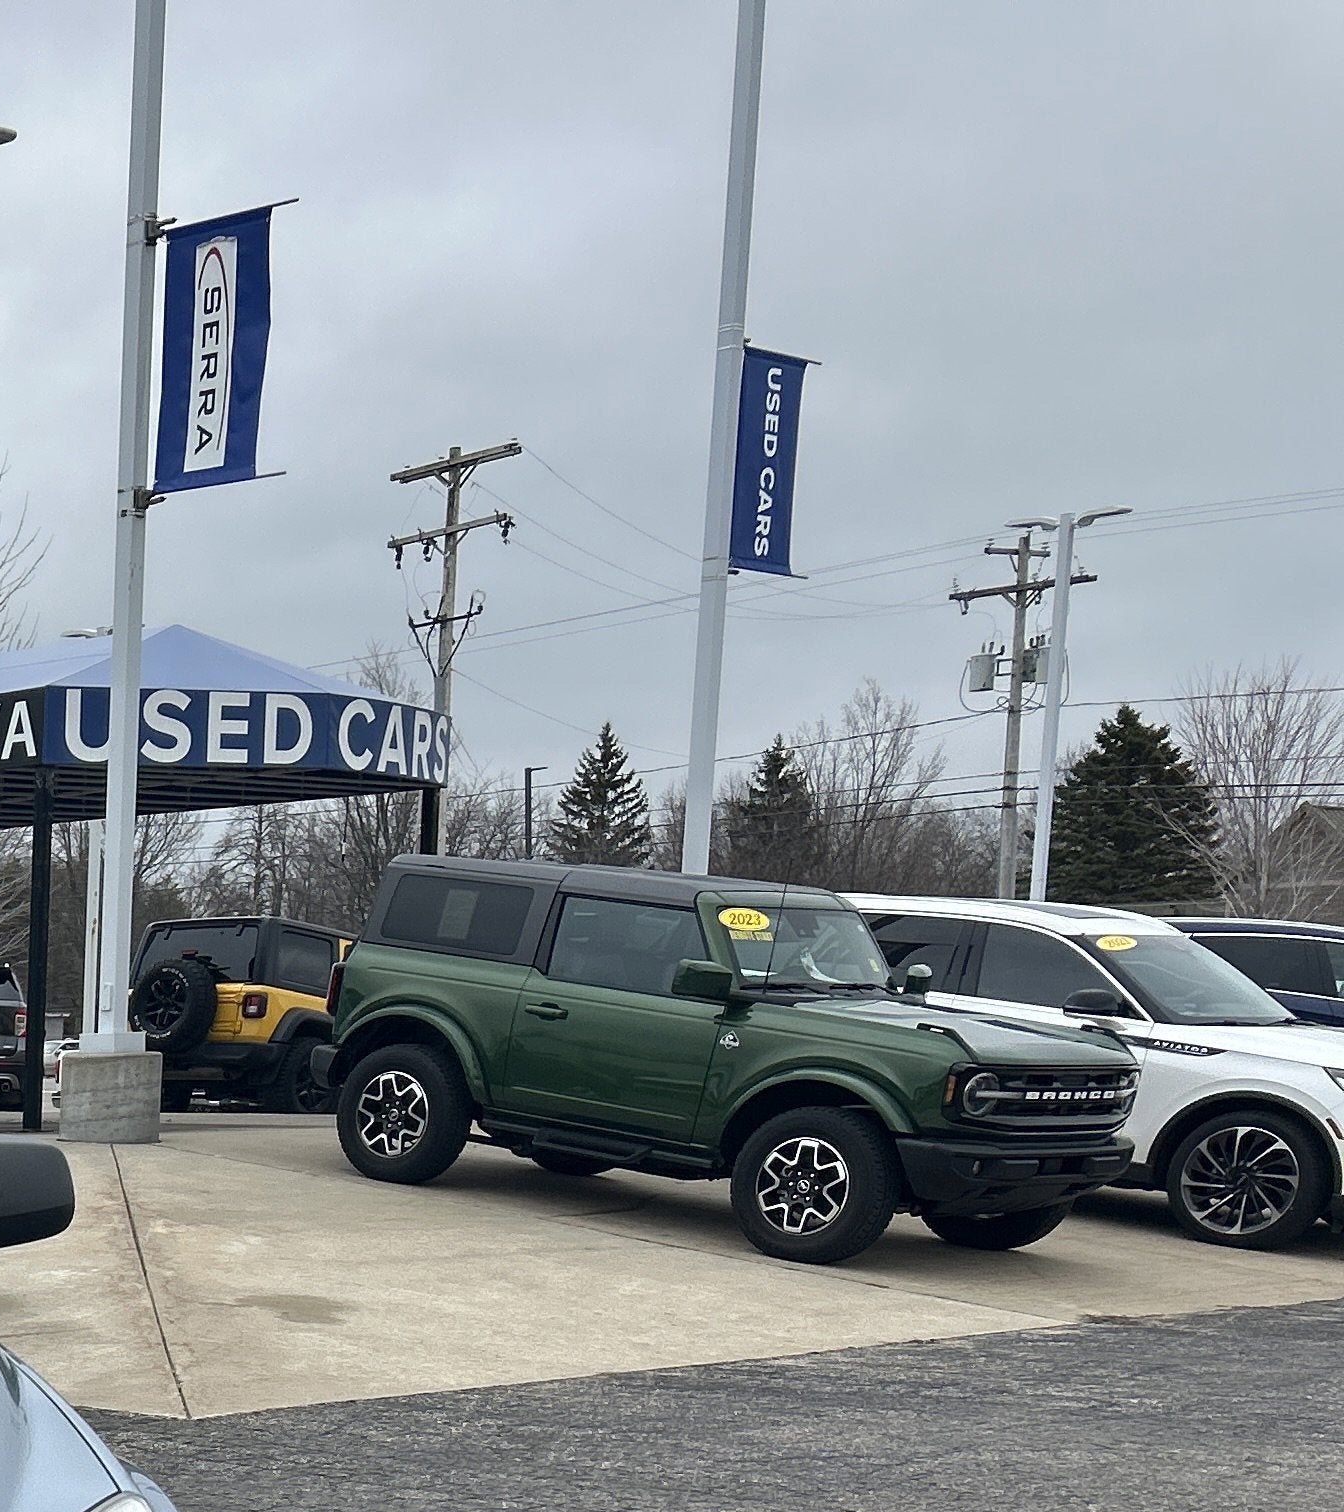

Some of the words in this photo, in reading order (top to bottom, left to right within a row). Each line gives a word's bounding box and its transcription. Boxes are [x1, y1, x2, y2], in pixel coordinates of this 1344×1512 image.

[194, 286, 222, 455] SERRA
[763, 367, 783, 458] USED
[754, 466, 775, 557] CARS
[64, 687, 313, 764] USED
[337, 698, 448, 785] CARS
[729, 913, 761, 925] 2023
[1153, 1041, 1209, 1053] AVIATOR
[1025, 1090, 1116, 1100] BRONCO
